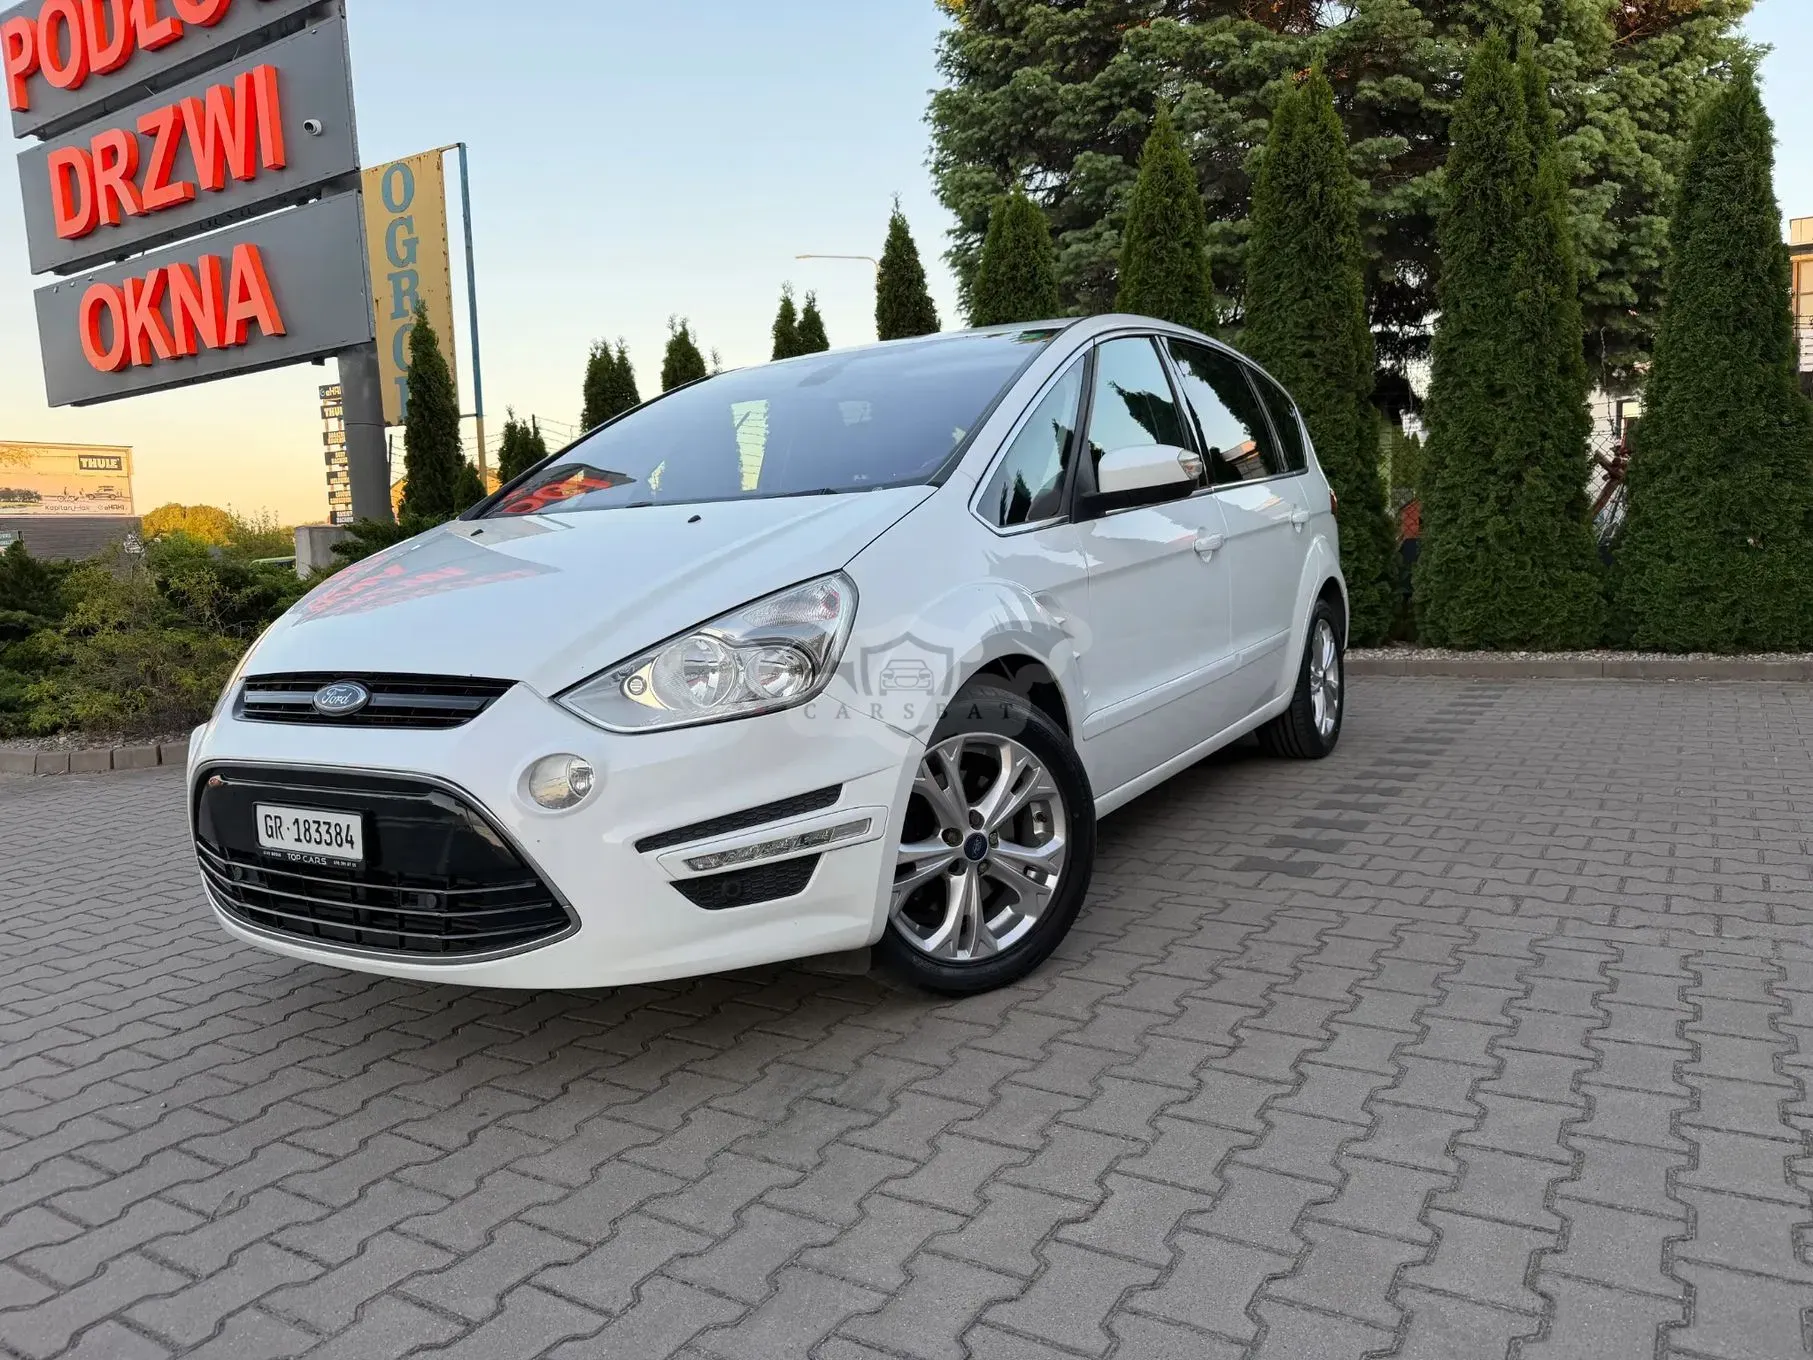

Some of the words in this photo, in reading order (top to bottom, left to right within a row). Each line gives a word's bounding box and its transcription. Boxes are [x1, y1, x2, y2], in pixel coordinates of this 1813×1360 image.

[47, 64, 286, 239] DRZWI
[79, 243, 287, 372] OKNA
[80, 457, 119, 469] THULE
[321, 687, 353, 706] Ford
[287, 852, 301, 862] TOP
[302, 855, 327, 866] CARS
